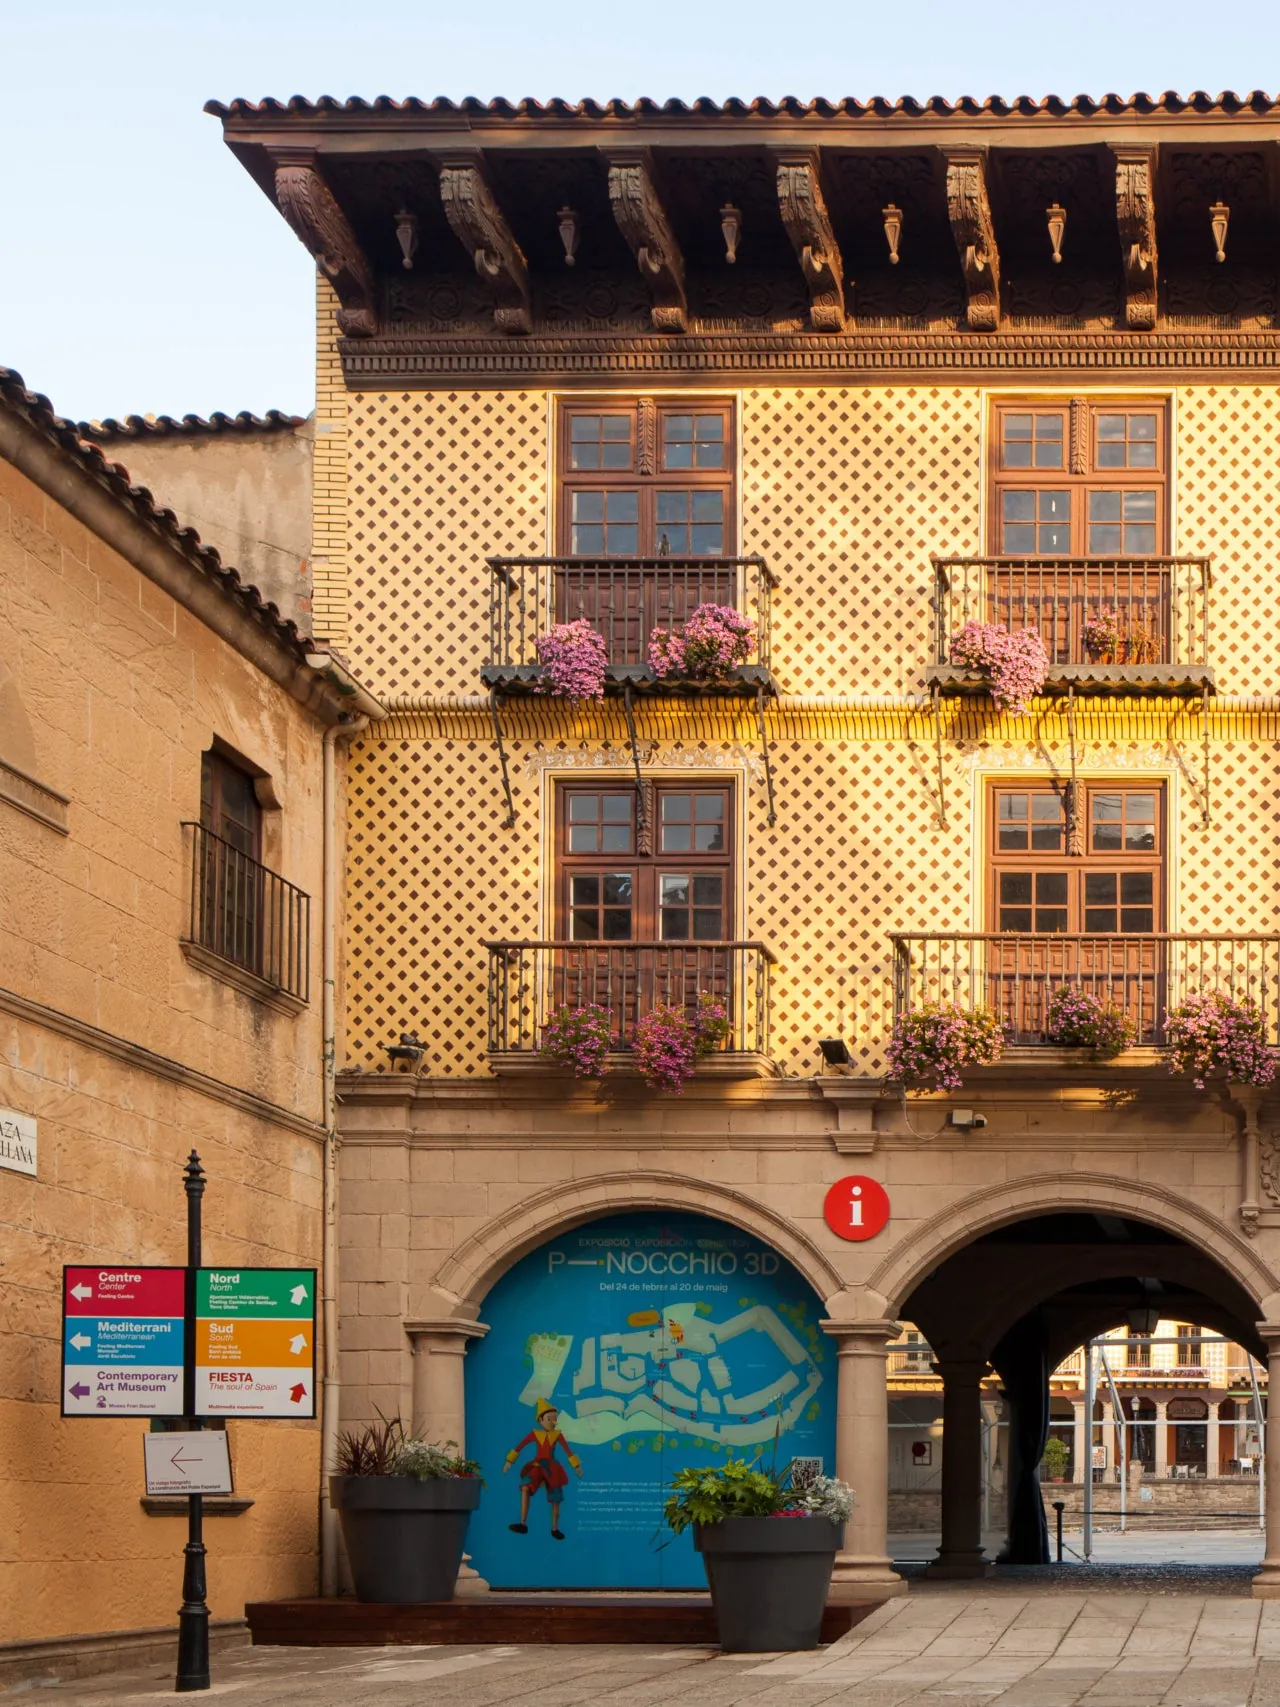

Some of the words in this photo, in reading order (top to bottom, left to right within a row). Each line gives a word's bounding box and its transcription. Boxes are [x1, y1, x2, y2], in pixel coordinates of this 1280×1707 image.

[0, 1140, 33, 1164] LLANA
[849, 1186, 864, 1226] i
[743, 1252, 780, 1275] 3D
[98, 1272, 142, 1282] Centre
[210, 1274, 240, 1284] Nord
[600, 1283, 615, 1291] Del
[616, 1283, 627, 1291] 24
[629, 1283, 640, 1291] de
[642, 1283, 668, 1291] febrer
[670, 1283, 678, 1291] al
[680, 1283, 691, 1291] 20
[693, 1283, 704, 1291] de
[706, 1283, 728, 1292] maig
[98, 1322, 171, 1332] Mediterrani
[210, 1324, 233, 1333] Sud
[98, 1332, 156, 1340] Mediterranean
[210, 1333, 233, 1342] South
[97, 1371, 178, 1382] Contemporary
[209, 1373, 253, 1382] FIESTA
[97, 1383, 114, 1391] Art
[118, 1383, 166, 1392] Museum
[255, 1383, 278, 1392] Spain
